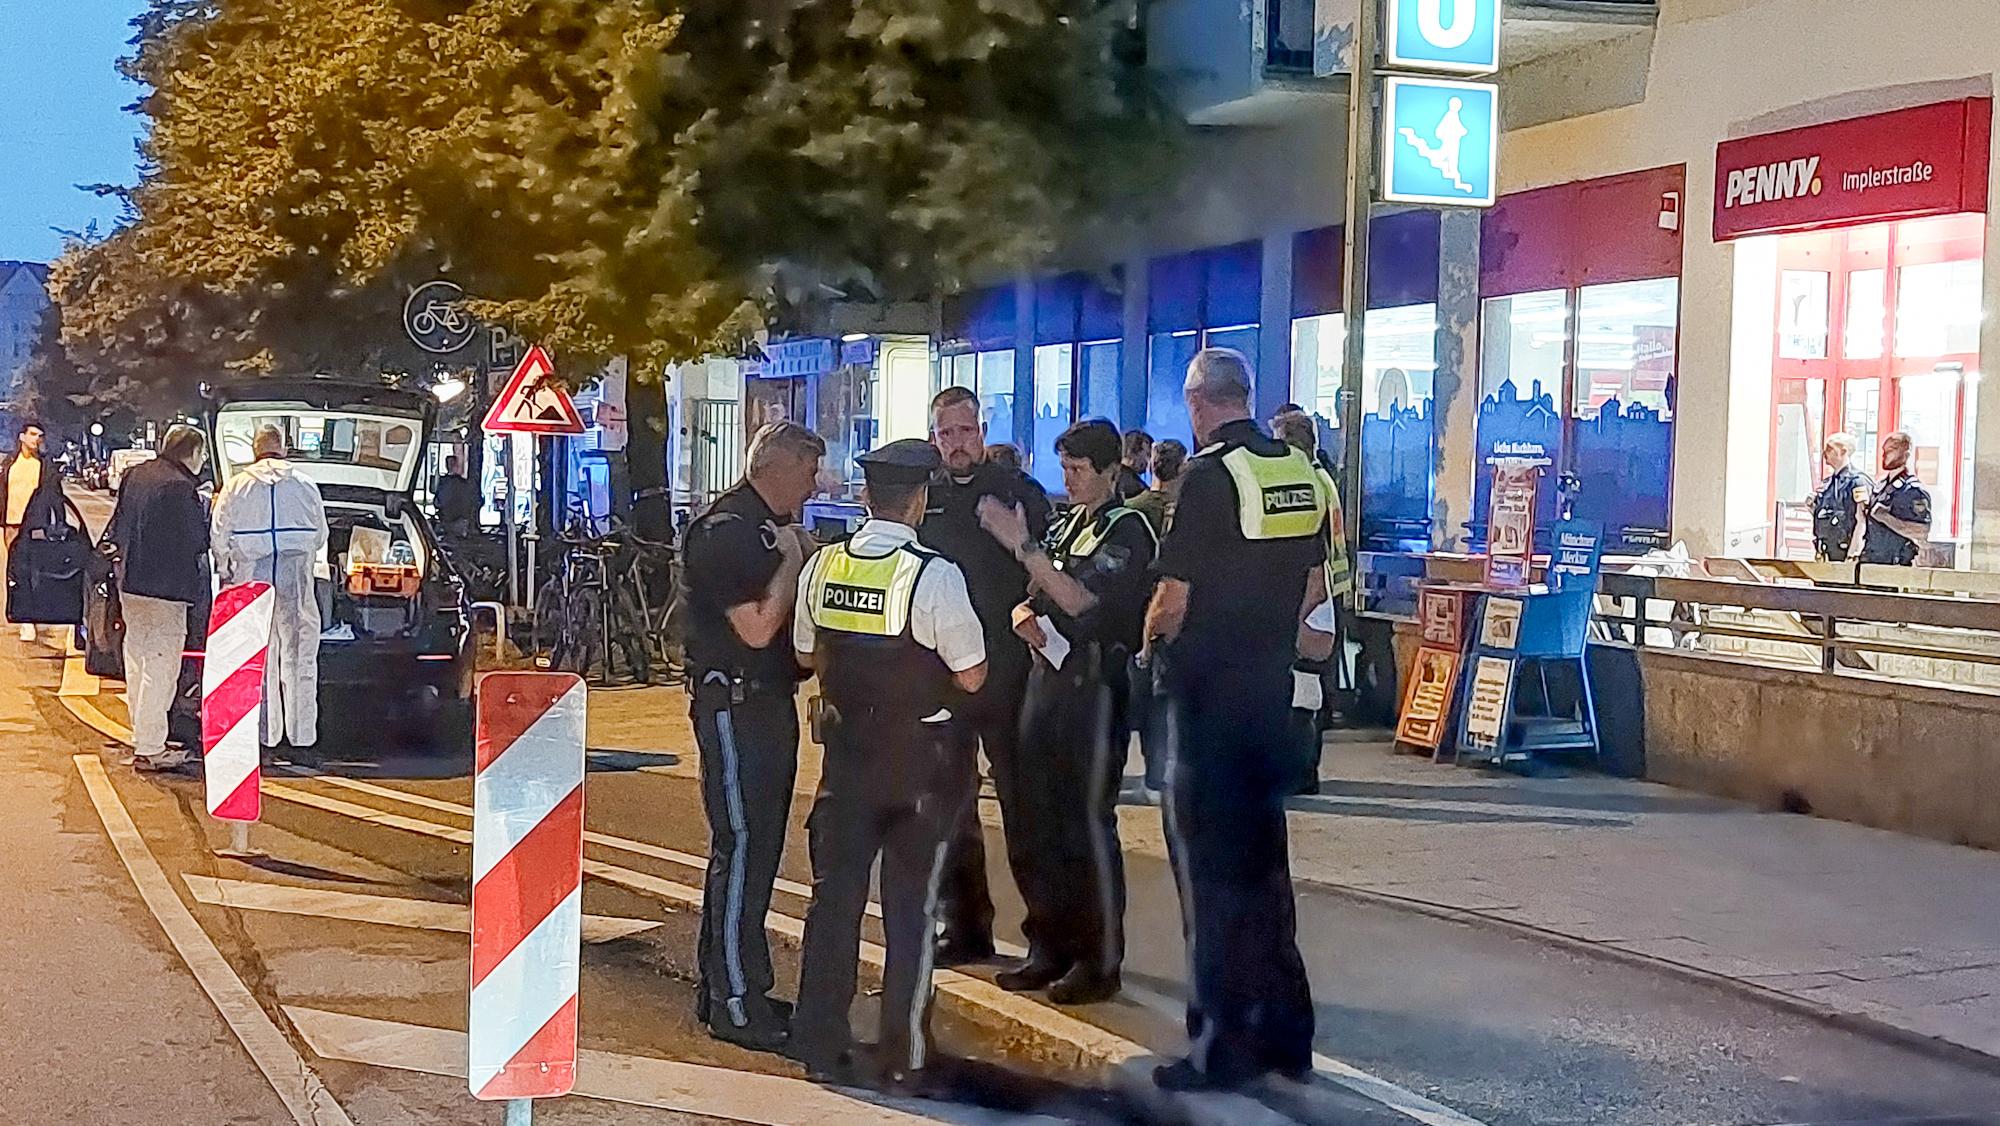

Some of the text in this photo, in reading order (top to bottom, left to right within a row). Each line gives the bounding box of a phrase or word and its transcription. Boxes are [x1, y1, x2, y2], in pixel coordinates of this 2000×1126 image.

[1417, 0, 1476, 48] U
[1842, 161, 1932, 192] Implerstraße
[824, 588, 883, 611] POLIZEI
